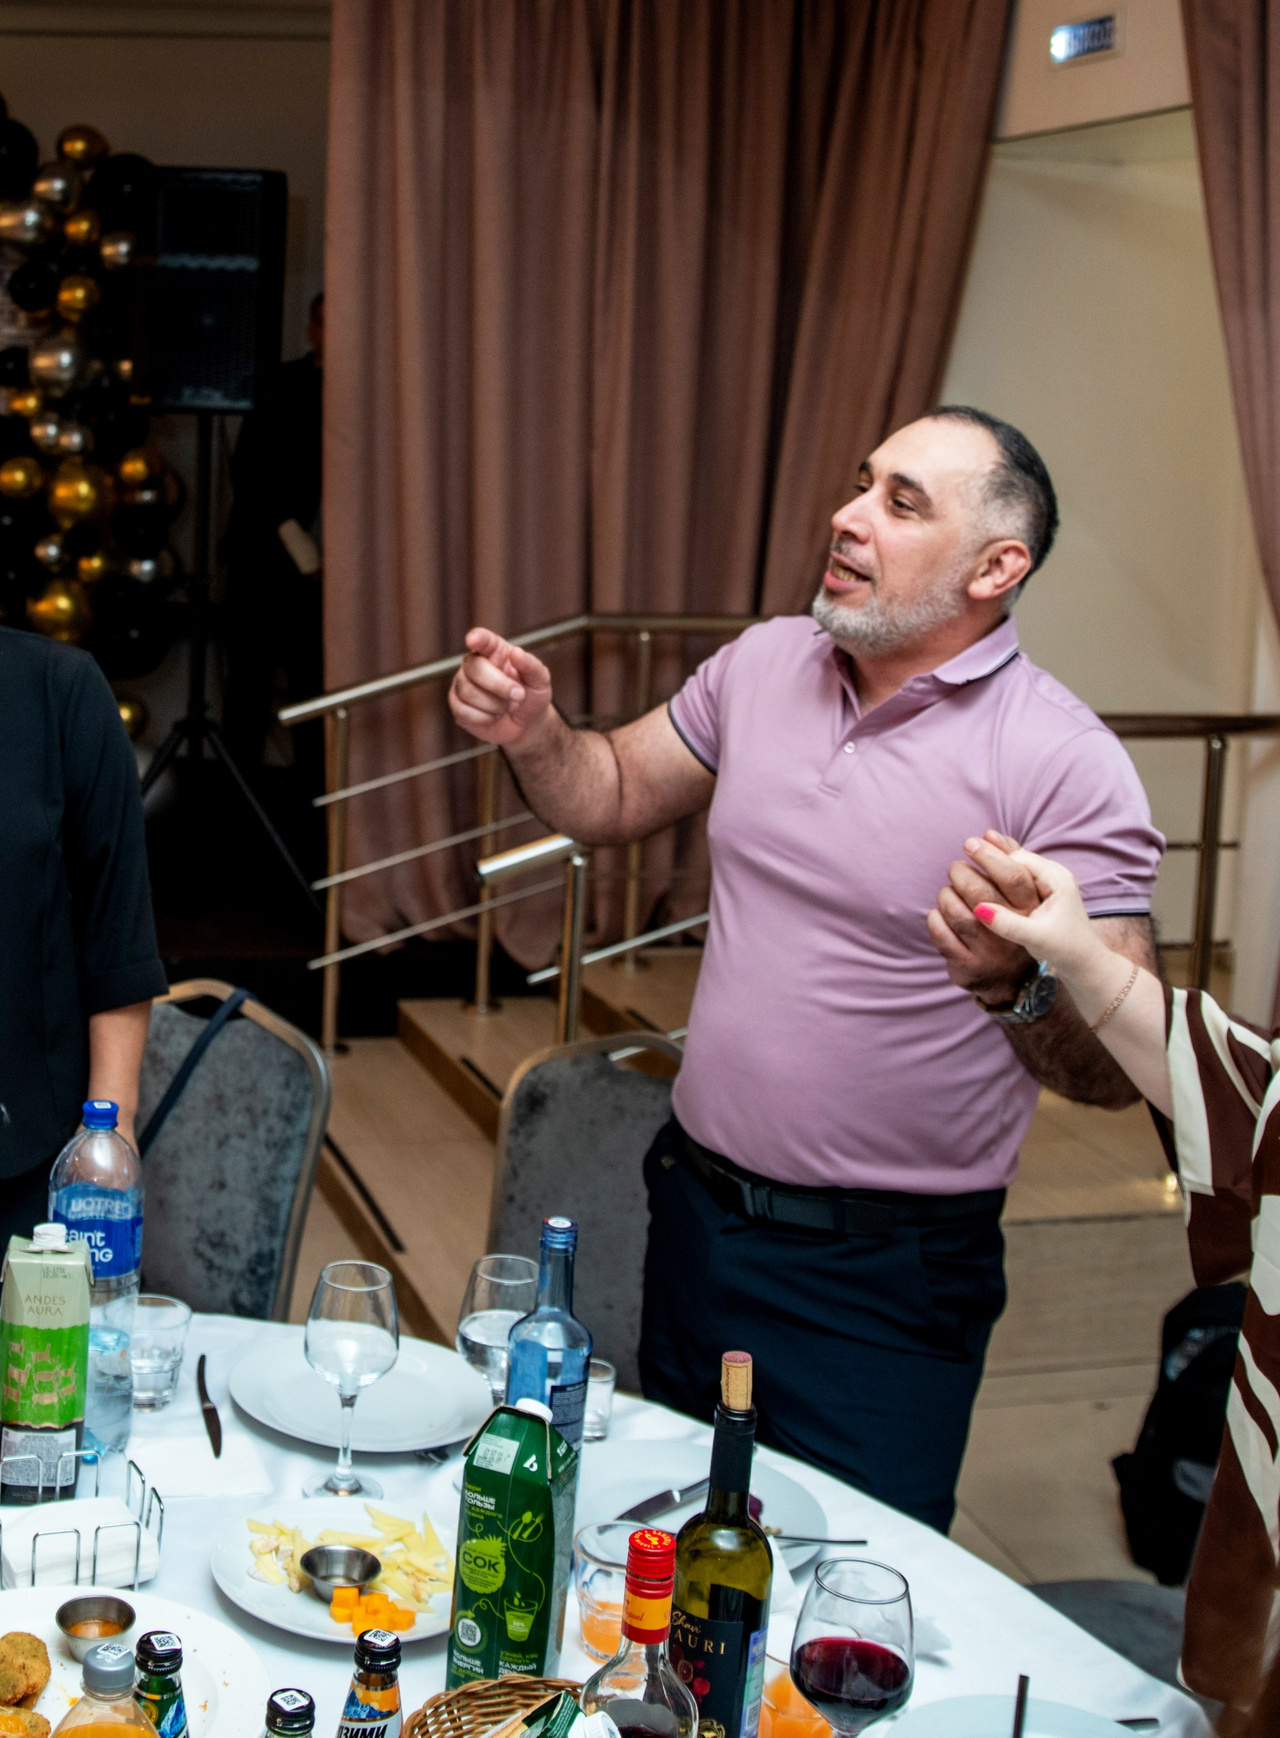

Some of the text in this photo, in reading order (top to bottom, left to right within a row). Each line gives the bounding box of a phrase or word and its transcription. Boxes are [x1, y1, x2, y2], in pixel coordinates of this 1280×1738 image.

[65, 1230, 106, 1248] aint
[24, 1295, 66, 1306] ANDES
[27, 1306, 63, 1316] AURA
[463, 1551, 500, 1574] СОК
[674, 1629, 726, 1655] AURI
